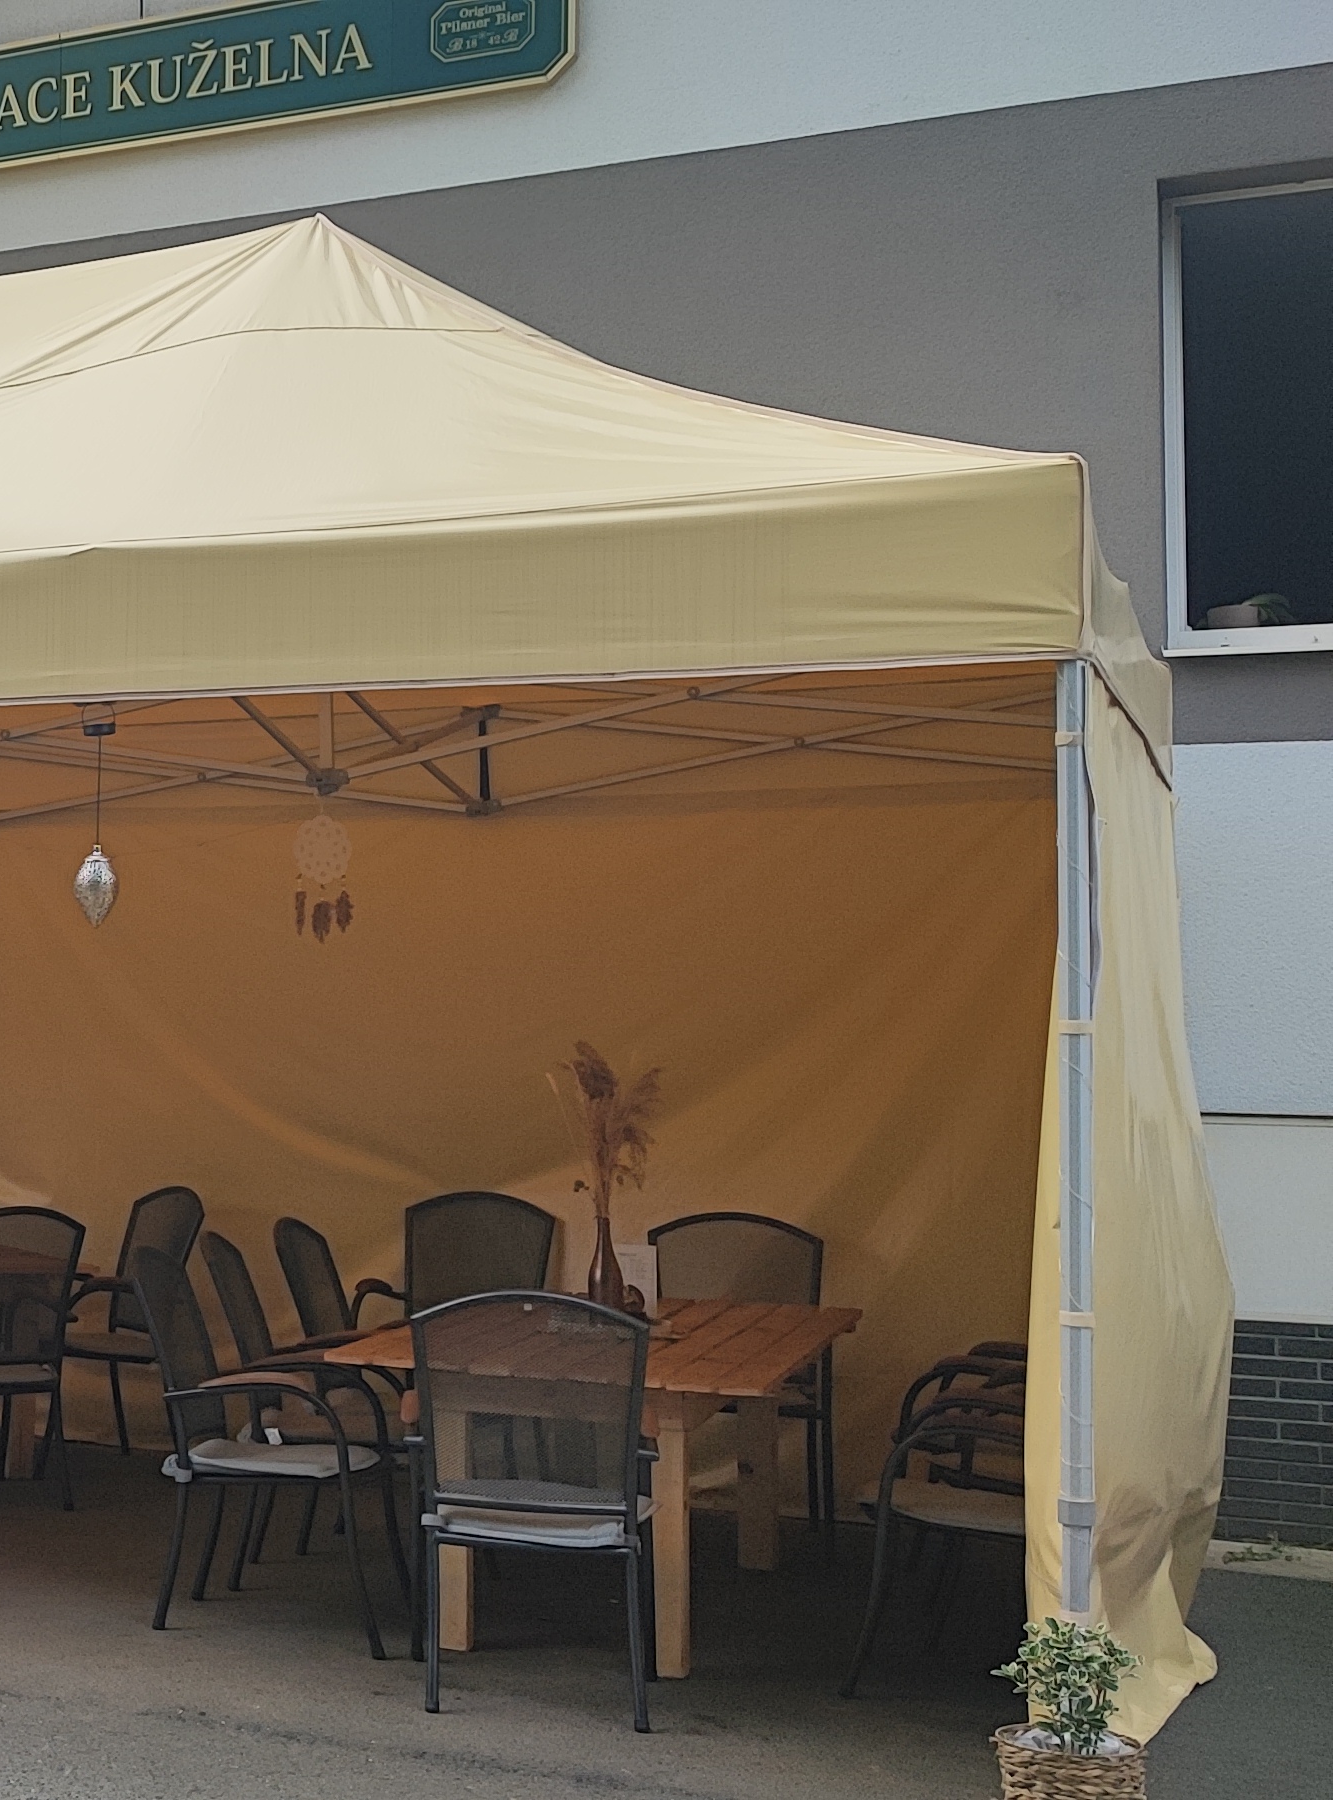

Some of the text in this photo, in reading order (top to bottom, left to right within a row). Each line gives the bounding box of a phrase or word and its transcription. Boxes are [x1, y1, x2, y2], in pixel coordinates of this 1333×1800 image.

[459, 1, 507, 19] Original
[440, 11, 526, 35] Pilsner Bier
[107, 23, 373, 112] KUŽELNA
